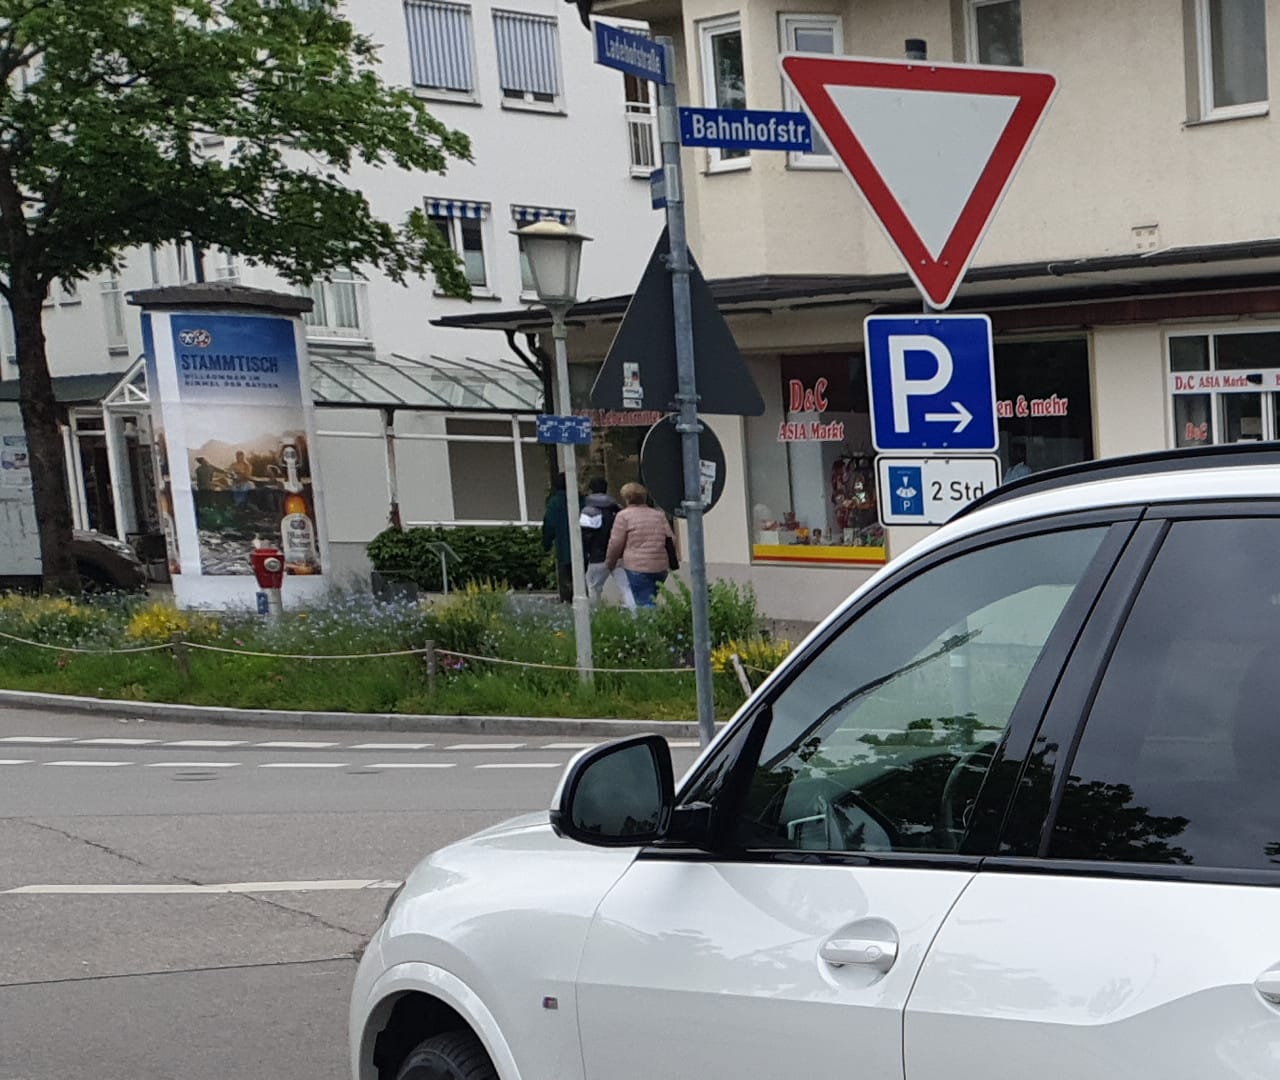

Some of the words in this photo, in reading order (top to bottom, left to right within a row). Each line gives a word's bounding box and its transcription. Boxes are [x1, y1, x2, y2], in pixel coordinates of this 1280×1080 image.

[604, 31, 660, 75] Ladehofstraße
[691, 114, 810, 144] Bahnhofstr.
[181, 354, 278, 373] STAMMTISCH
[888, 335, 953, 433] P
[1199, 376, 1220, 388] ASIA
[789, 378, 828, 413] D&C
[1016, 395, 1029, 417] &
[1031, 394, 1068, 416] mehr
[777, 421, 807, 441] ASIA
[810, 420, 844, 441] Markt
[931, 481, 943, 501] 2
